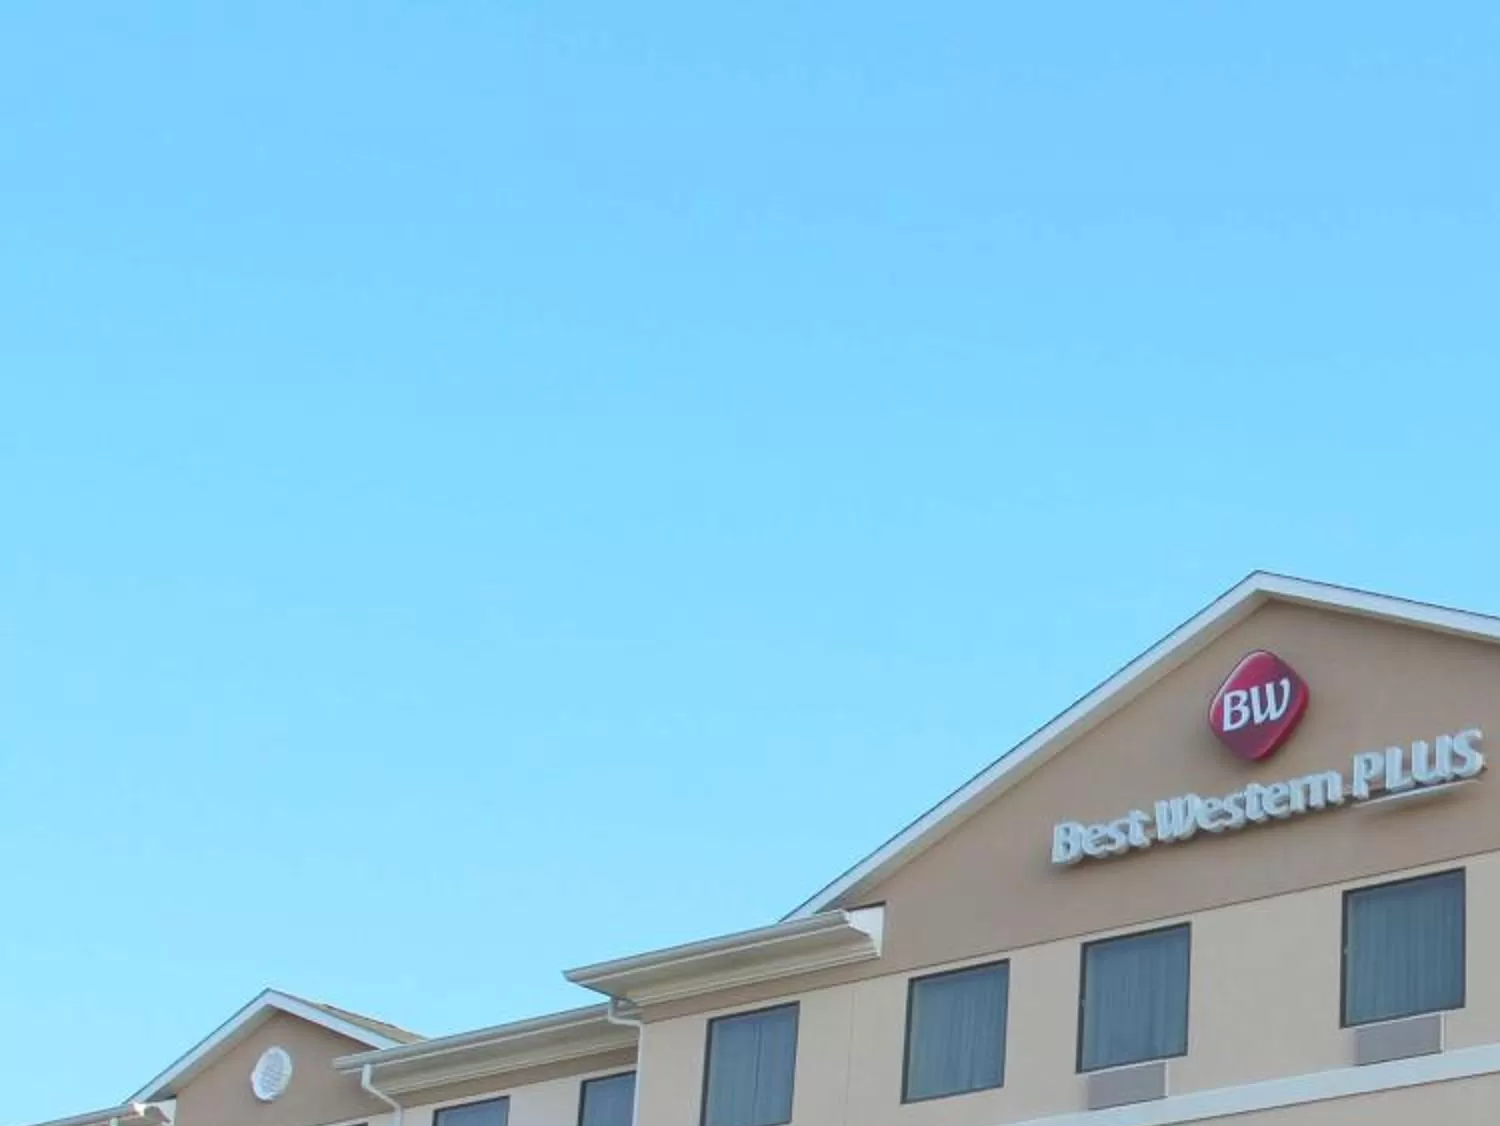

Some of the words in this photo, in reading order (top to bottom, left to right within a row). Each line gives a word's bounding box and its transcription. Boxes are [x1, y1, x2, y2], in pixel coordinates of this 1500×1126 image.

[1222, 678, 1291, 732] BW
[1051, 809, 1151, 865] Best
[1154, 769, 1344, 842] Western
[1351, 726, 1486, 799] PLUS
